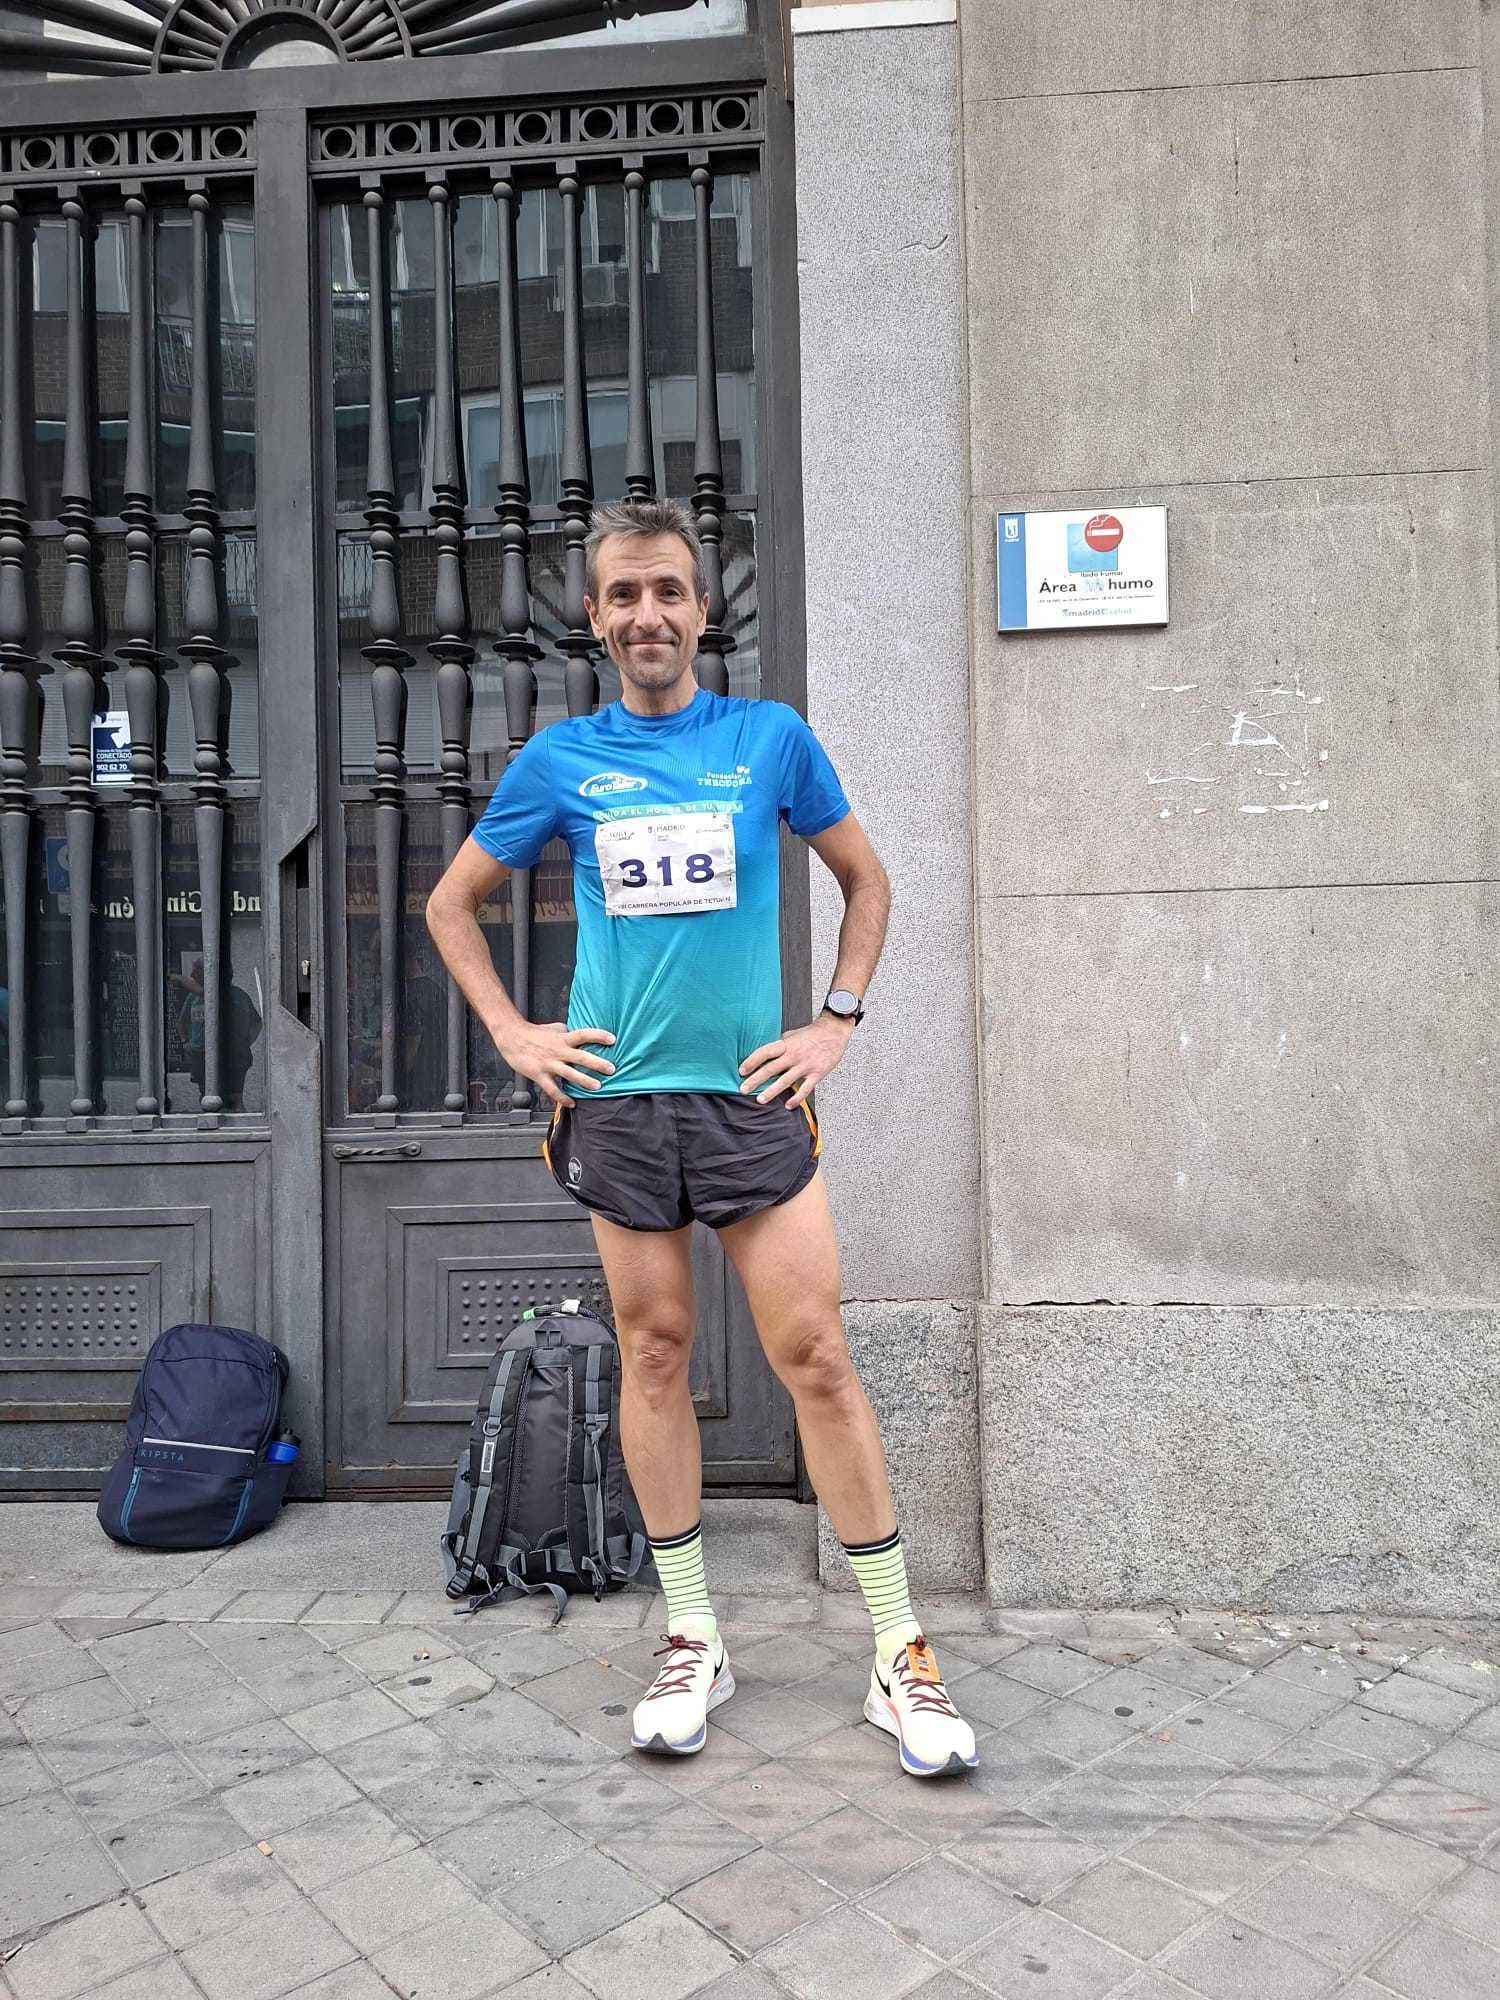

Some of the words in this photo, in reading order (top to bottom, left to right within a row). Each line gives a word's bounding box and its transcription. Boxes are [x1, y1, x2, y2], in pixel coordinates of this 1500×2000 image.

[1039, 577, 1077, 593] Área
[1108, 577, 1154, 590] humo
[96, 752, 132, 760] CONECTADO
[685, 804, 697, 812] DE
[656, 824, 686, 833] MADRID
[618, 853, 715, 888] 318
[659, 899, 692, 907] POPULAR
[140, 1449, 184, 1461] KIPSTA
